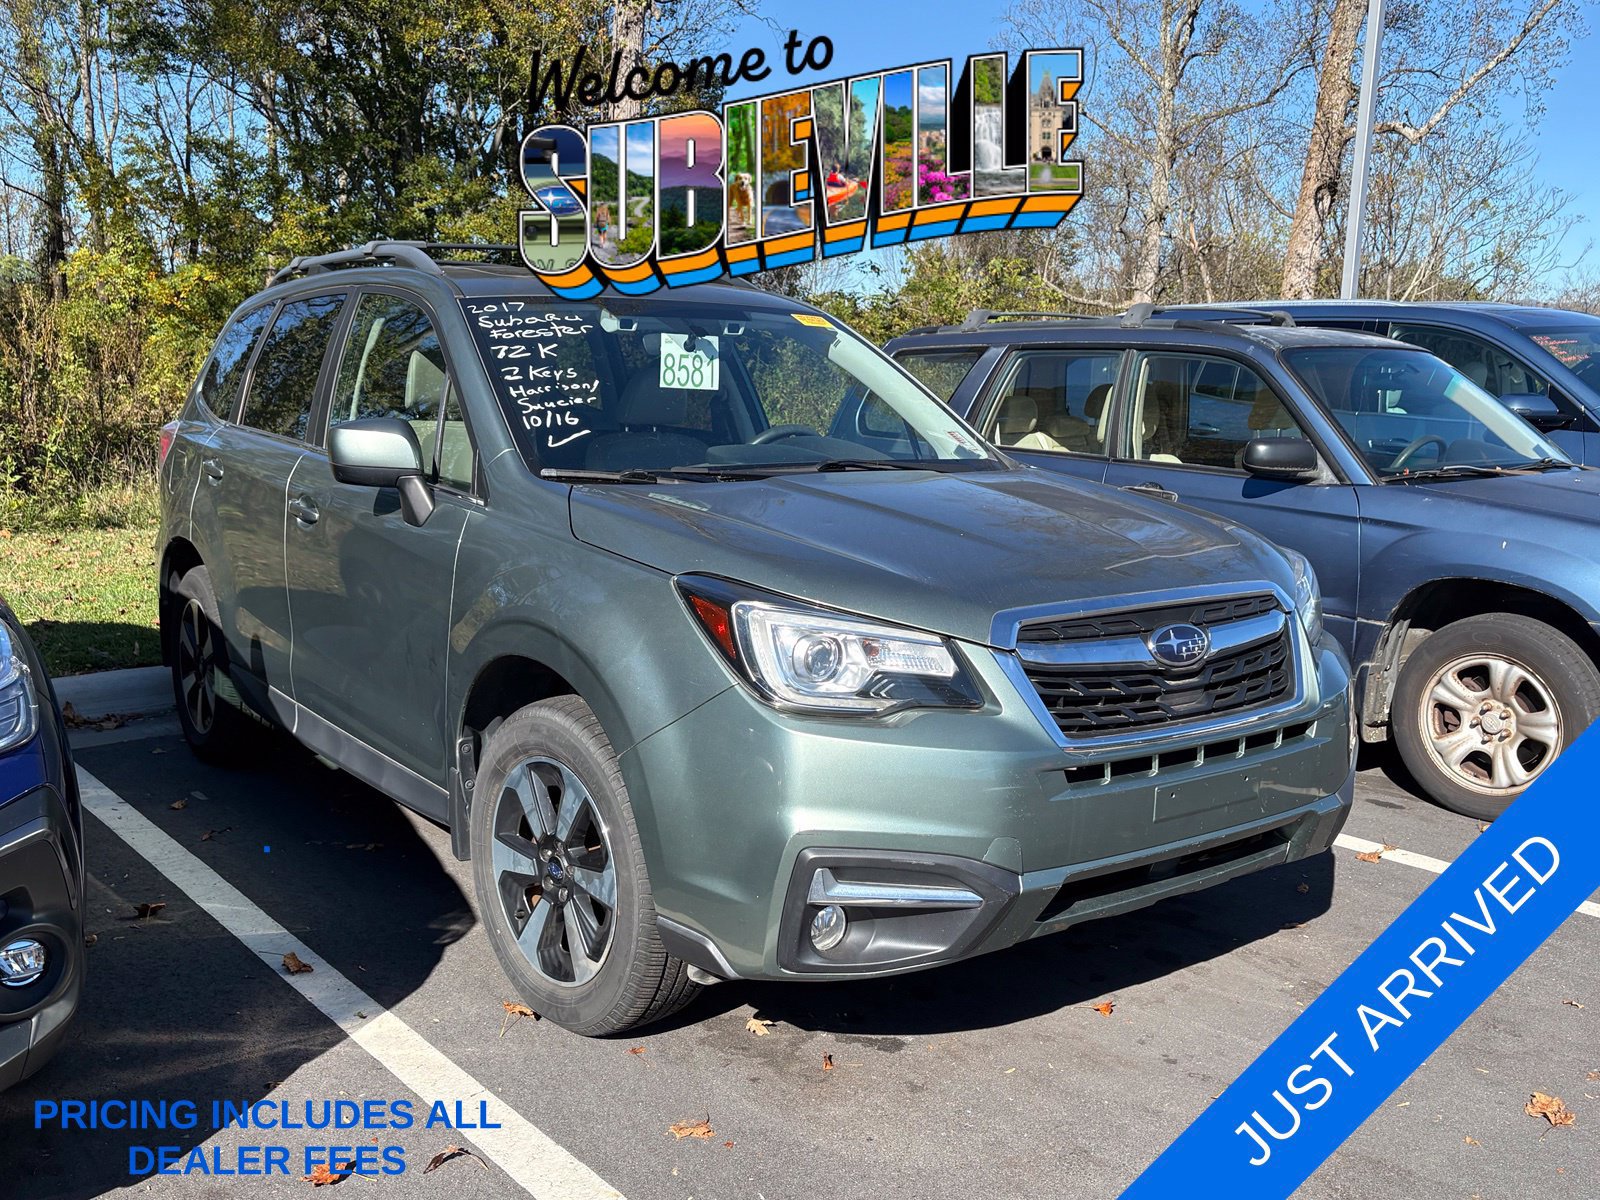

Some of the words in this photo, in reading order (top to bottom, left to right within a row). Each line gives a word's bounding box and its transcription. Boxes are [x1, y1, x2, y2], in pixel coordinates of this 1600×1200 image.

[467, 302, 525, 314] 2017
[489, 322, 594, 339] Forester
[490, 345, 532, 359] 72
[537, 343, 558, 359] K
[501, 366, 523, 380] 2
[529, 365, 577, 381] Keys
[662, 353, 714, 388] 8581
[522, 410, 580, 430] 10/16
